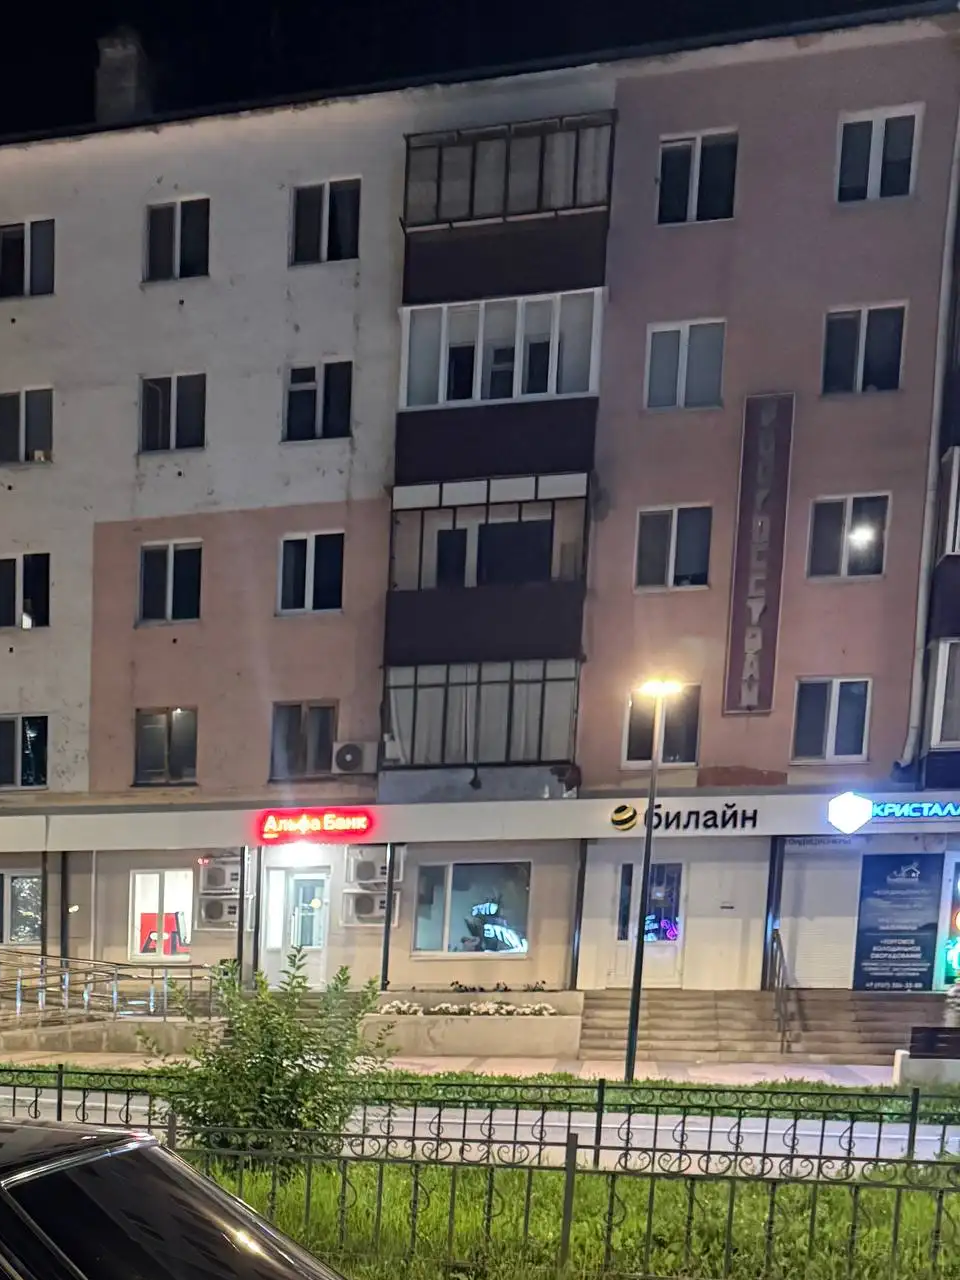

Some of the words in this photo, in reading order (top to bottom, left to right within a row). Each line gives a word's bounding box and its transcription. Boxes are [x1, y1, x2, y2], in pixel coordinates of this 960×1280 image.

[644, 803, 758, 830] билайн
[872, 802, 960, 817] КРИСТАЛ
[262, 814, 321, 838] Альфа
[323, 812, 368, 831] Банк
